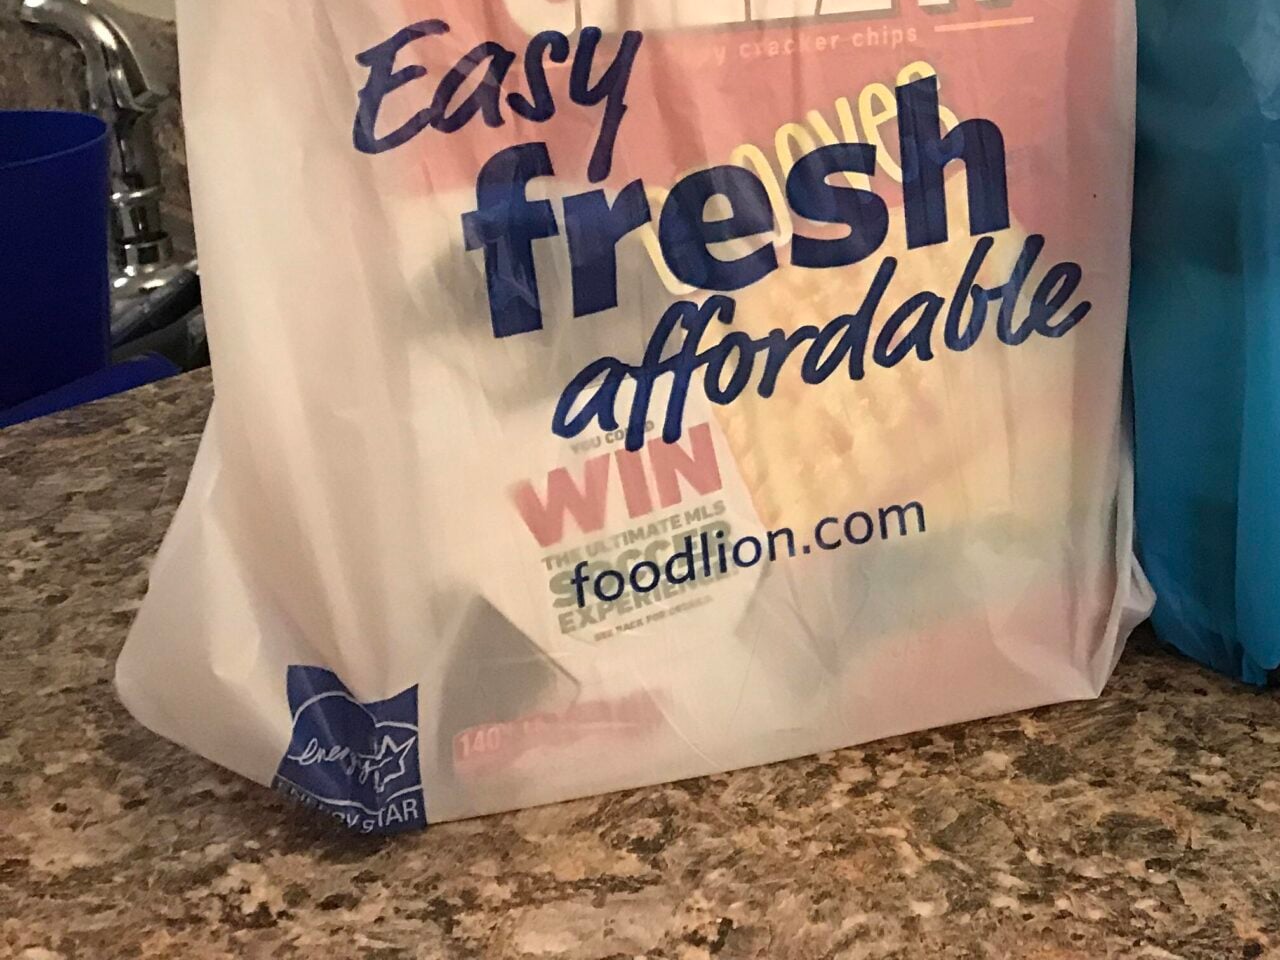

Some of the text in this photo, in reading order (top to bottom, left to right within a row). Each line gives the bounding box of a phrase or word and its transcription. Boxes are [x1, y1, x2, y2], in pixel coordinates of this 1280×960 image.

[852, 24, 918, 54] chips
[352, 18, 644, 184] Easy
[461, 74, 1011, 339] fresh
[551, 232, 1091, 452] affordable
[511, 422, 724, 548] WIN
[605, 420, 655, 444] COD
[570, 501, 927, 608] foodlion.com
[585, 514, 684, 557] ULTIMATE
[685, 500, 728, 526] MLS
[459, 726, 502, 757] 140
